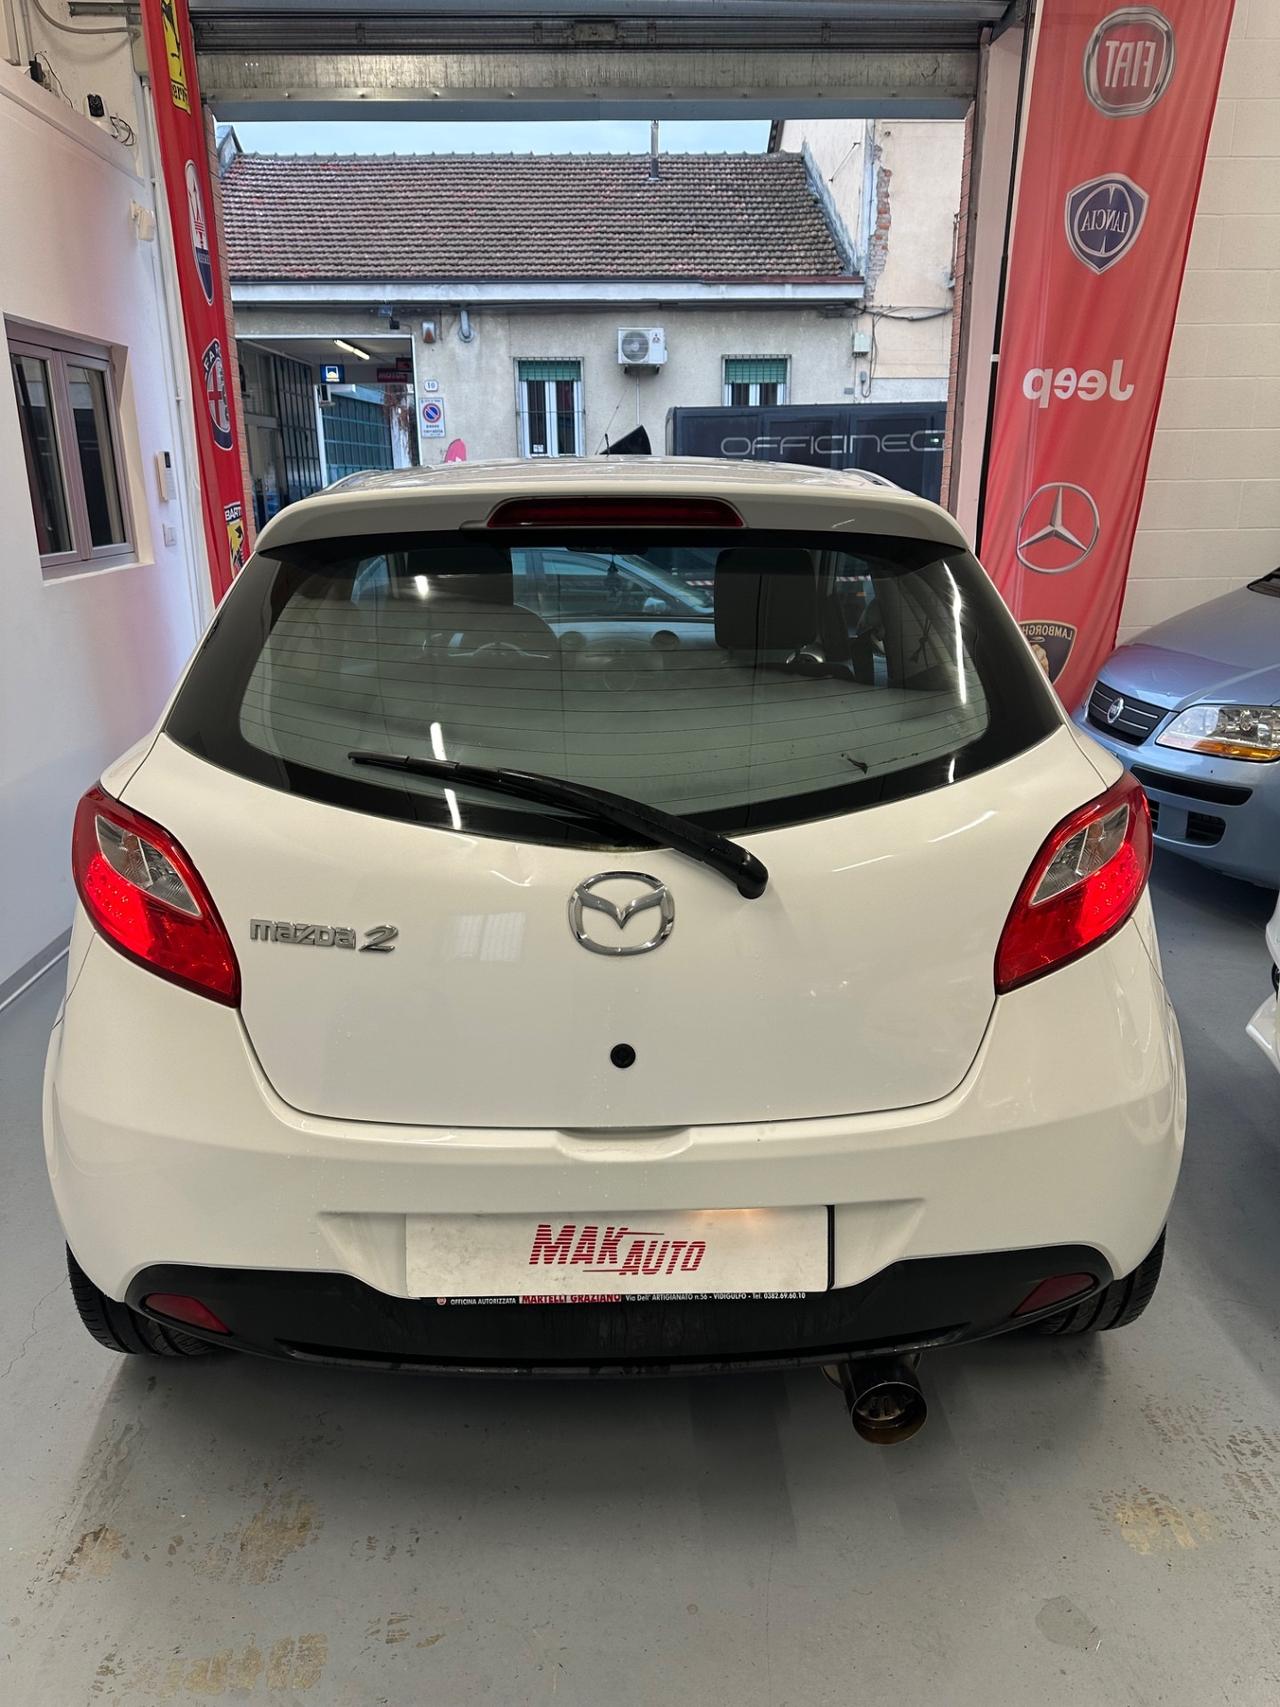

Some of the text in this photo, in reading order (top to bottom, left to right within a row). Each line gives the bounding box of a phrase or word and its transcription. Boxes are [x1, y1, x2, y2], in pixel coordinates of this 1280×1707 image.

[358, 924, 399, 952] 2
[529, 1224, 706, 1276] MAK AUTO
[450, 1298, 477, 1306] OFFICINA
[478, 1297, 517, 1305] AUTORIZZATA
[522, 1294, 567, 1304] MARTELLI
[570, 1293, 621, 1304] GRAZIANO
[625, 1294, 636, 1302] Via
[651, 1293, 694, 1301] ARTIGIANATO
